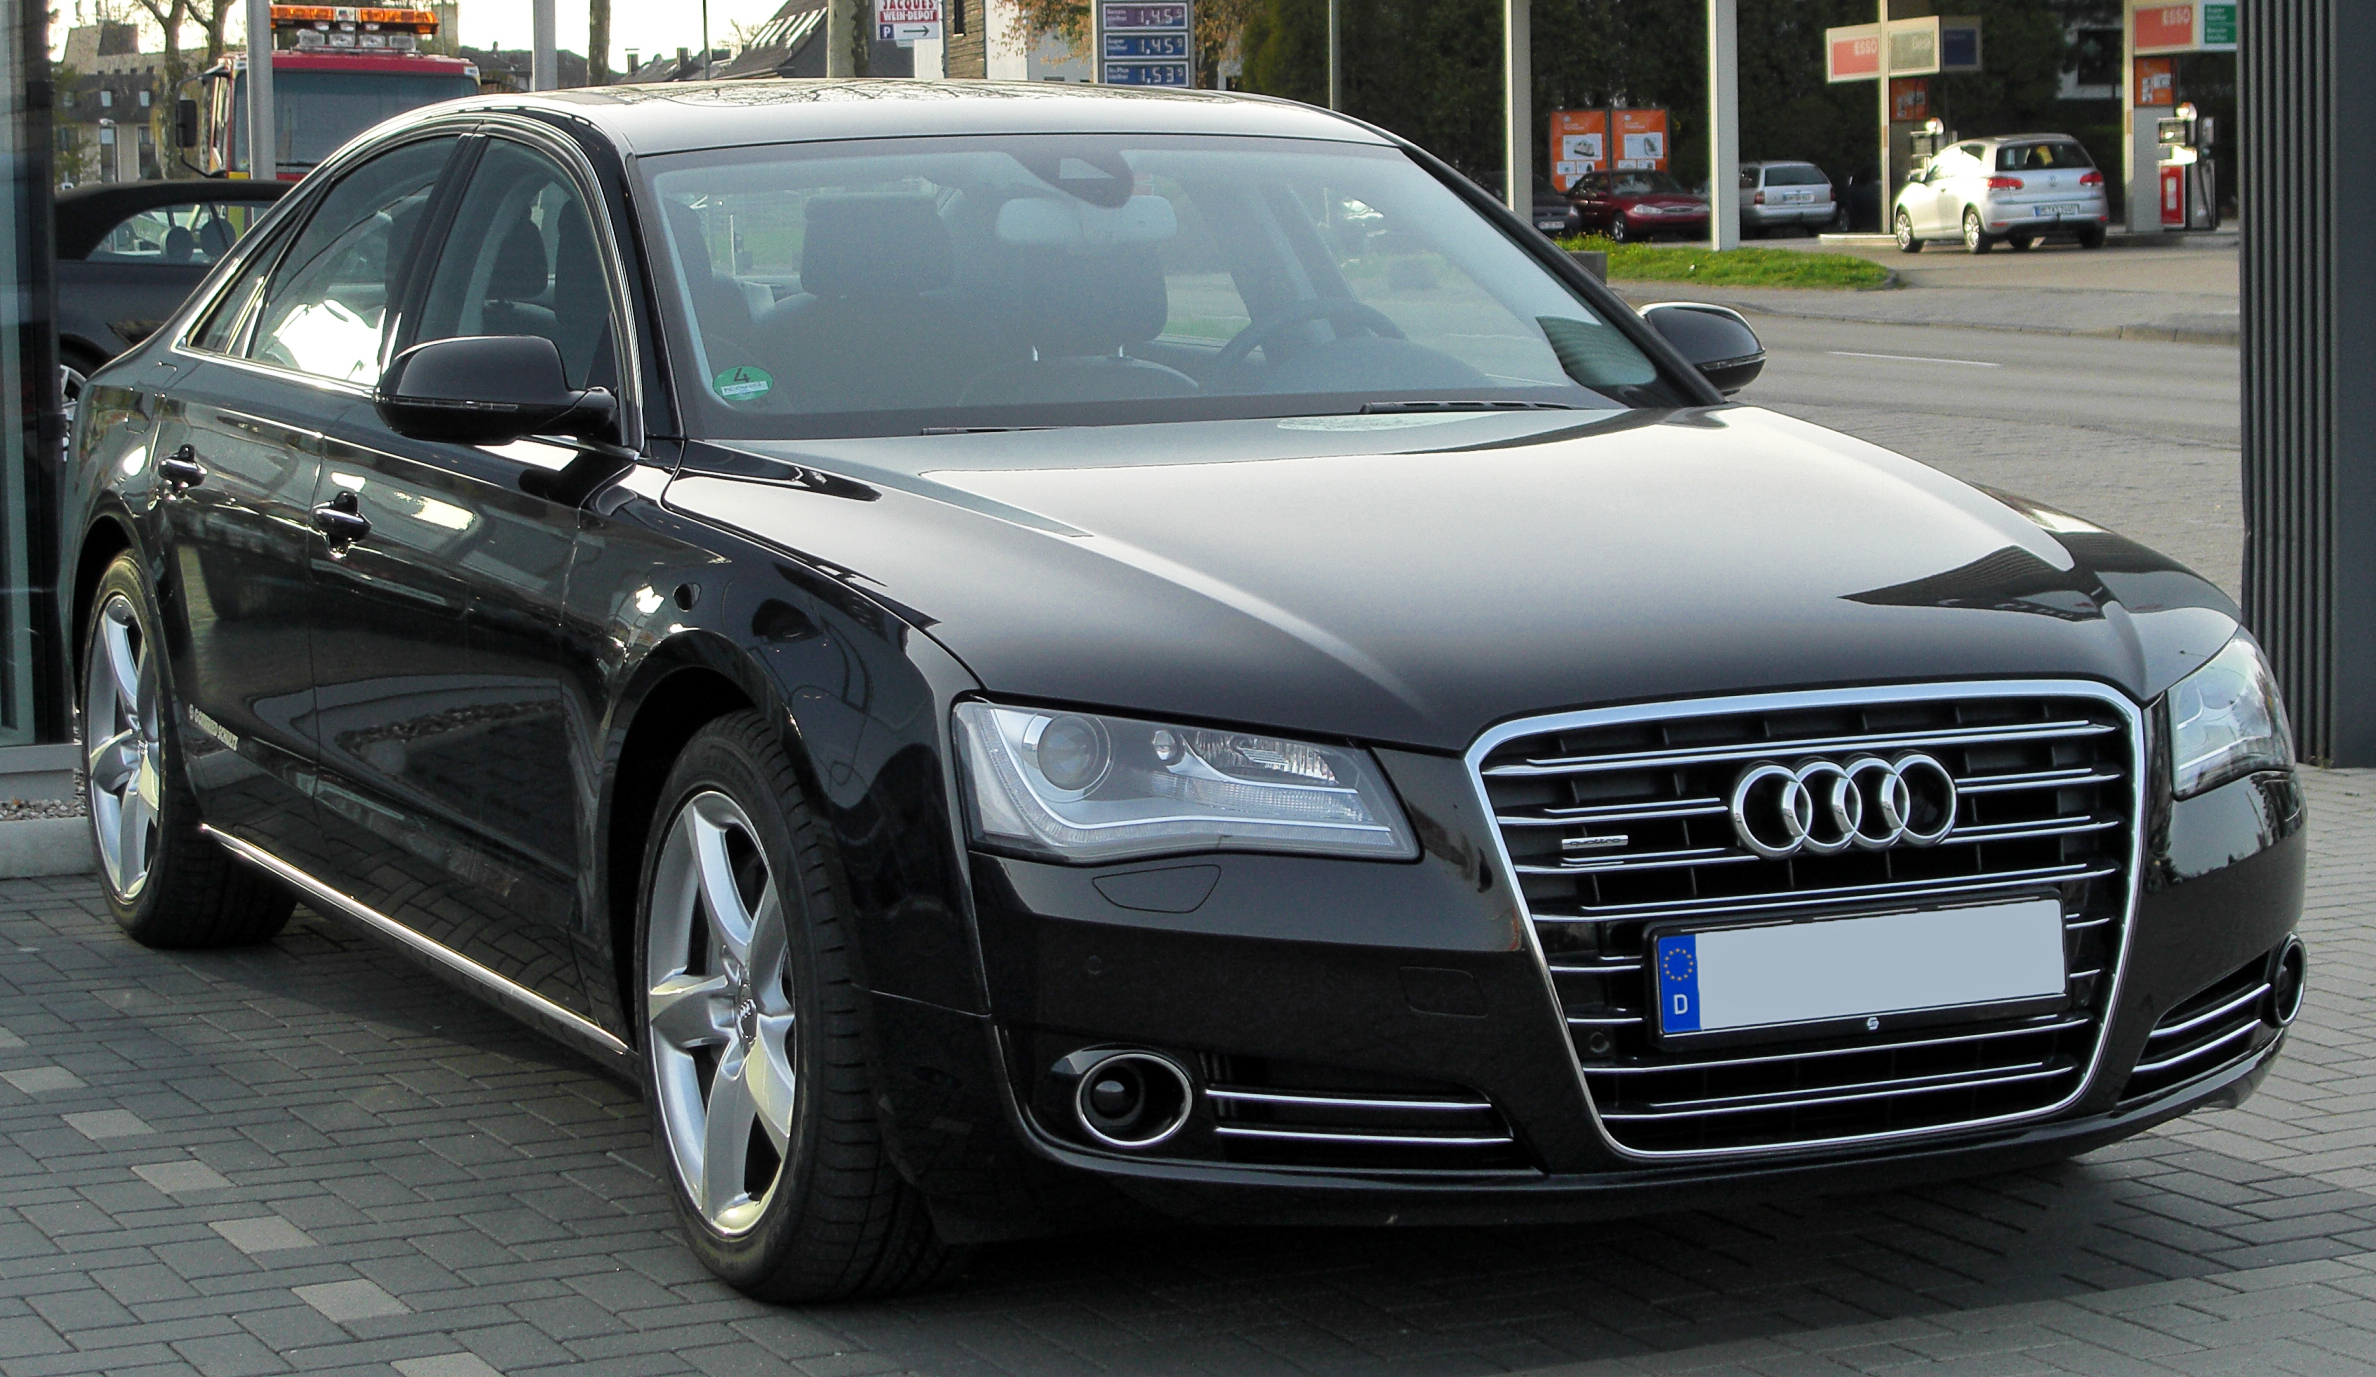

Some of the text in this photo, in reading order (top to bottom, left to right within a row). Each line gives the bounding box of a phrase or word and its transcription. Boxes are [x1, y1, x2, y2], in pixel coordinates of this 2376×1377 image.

[2162, 7, 2190, 25] ESSO
[883, 26, 891, 38] P
[1854, 39, 1877, 56] ESSO
[734, 367, 751, 382] 4
[1569, 838, 1621, 847] quattro
[1673, 993, 1688, 1015] D
